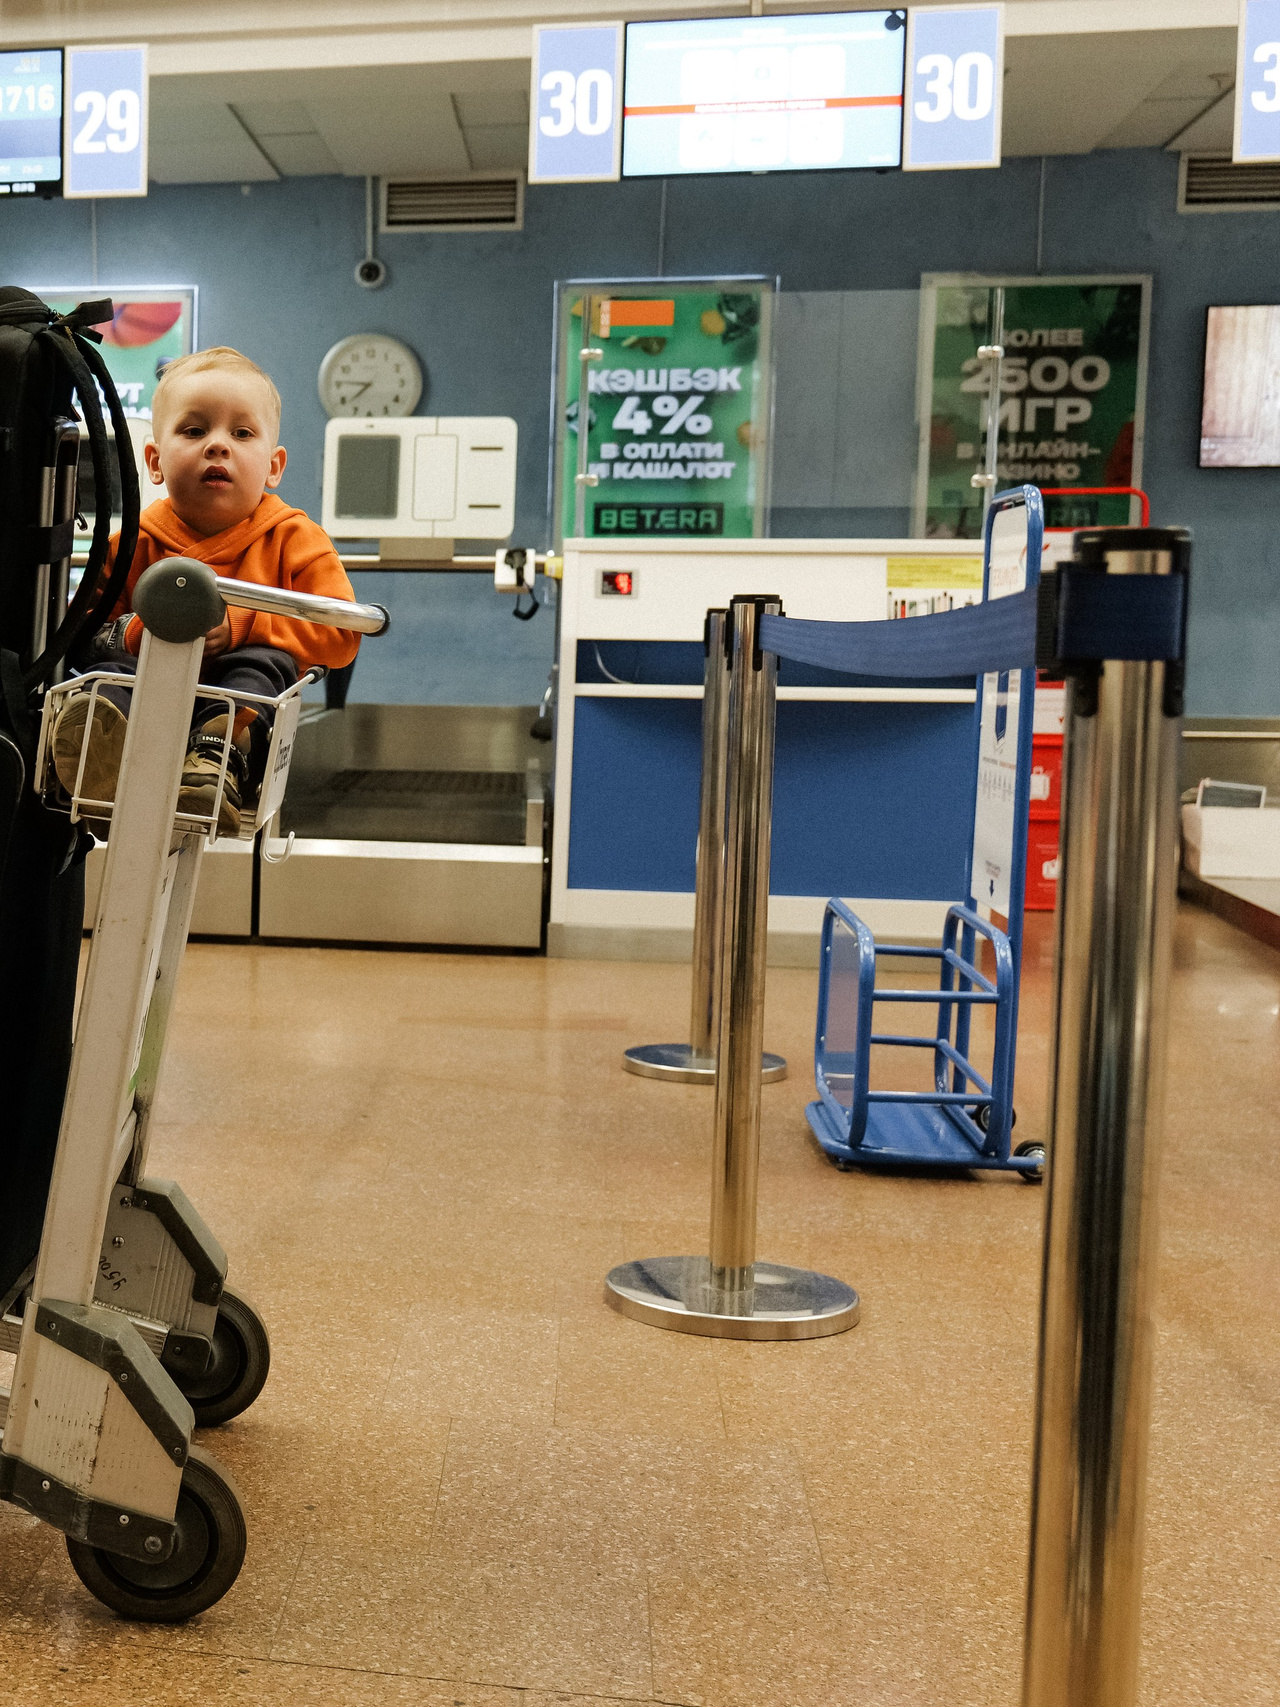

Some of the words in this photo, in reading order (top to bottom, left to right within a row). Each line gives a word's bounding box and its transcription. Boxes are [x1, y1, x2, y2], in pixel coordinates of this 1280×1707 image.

[914, 52, 993, 122] 30
[539, 69, 613, 137] 30
[73, 89, 141, 154] 29
[588, 367, 742, 393] КЭШБЭК
[960, 355, 1111, 393] 2500
[612, 395, 713, 435] 4%
[979, 396, 1092, 433] ИГР
[600, 443, 620, 460] В
[623, 442, 724, 460] ОПЛАТИ
[987, 438, 1101, 459] НЛАЙН-
[588, 463, 610, 479] И
[613, 462, 737, 479] КАШАЛОТ
[979, 463, 1080, 481] АЗИНО
[600, 508, 718, 530] BETERA
[202, 735, 237, 751] INDIO
